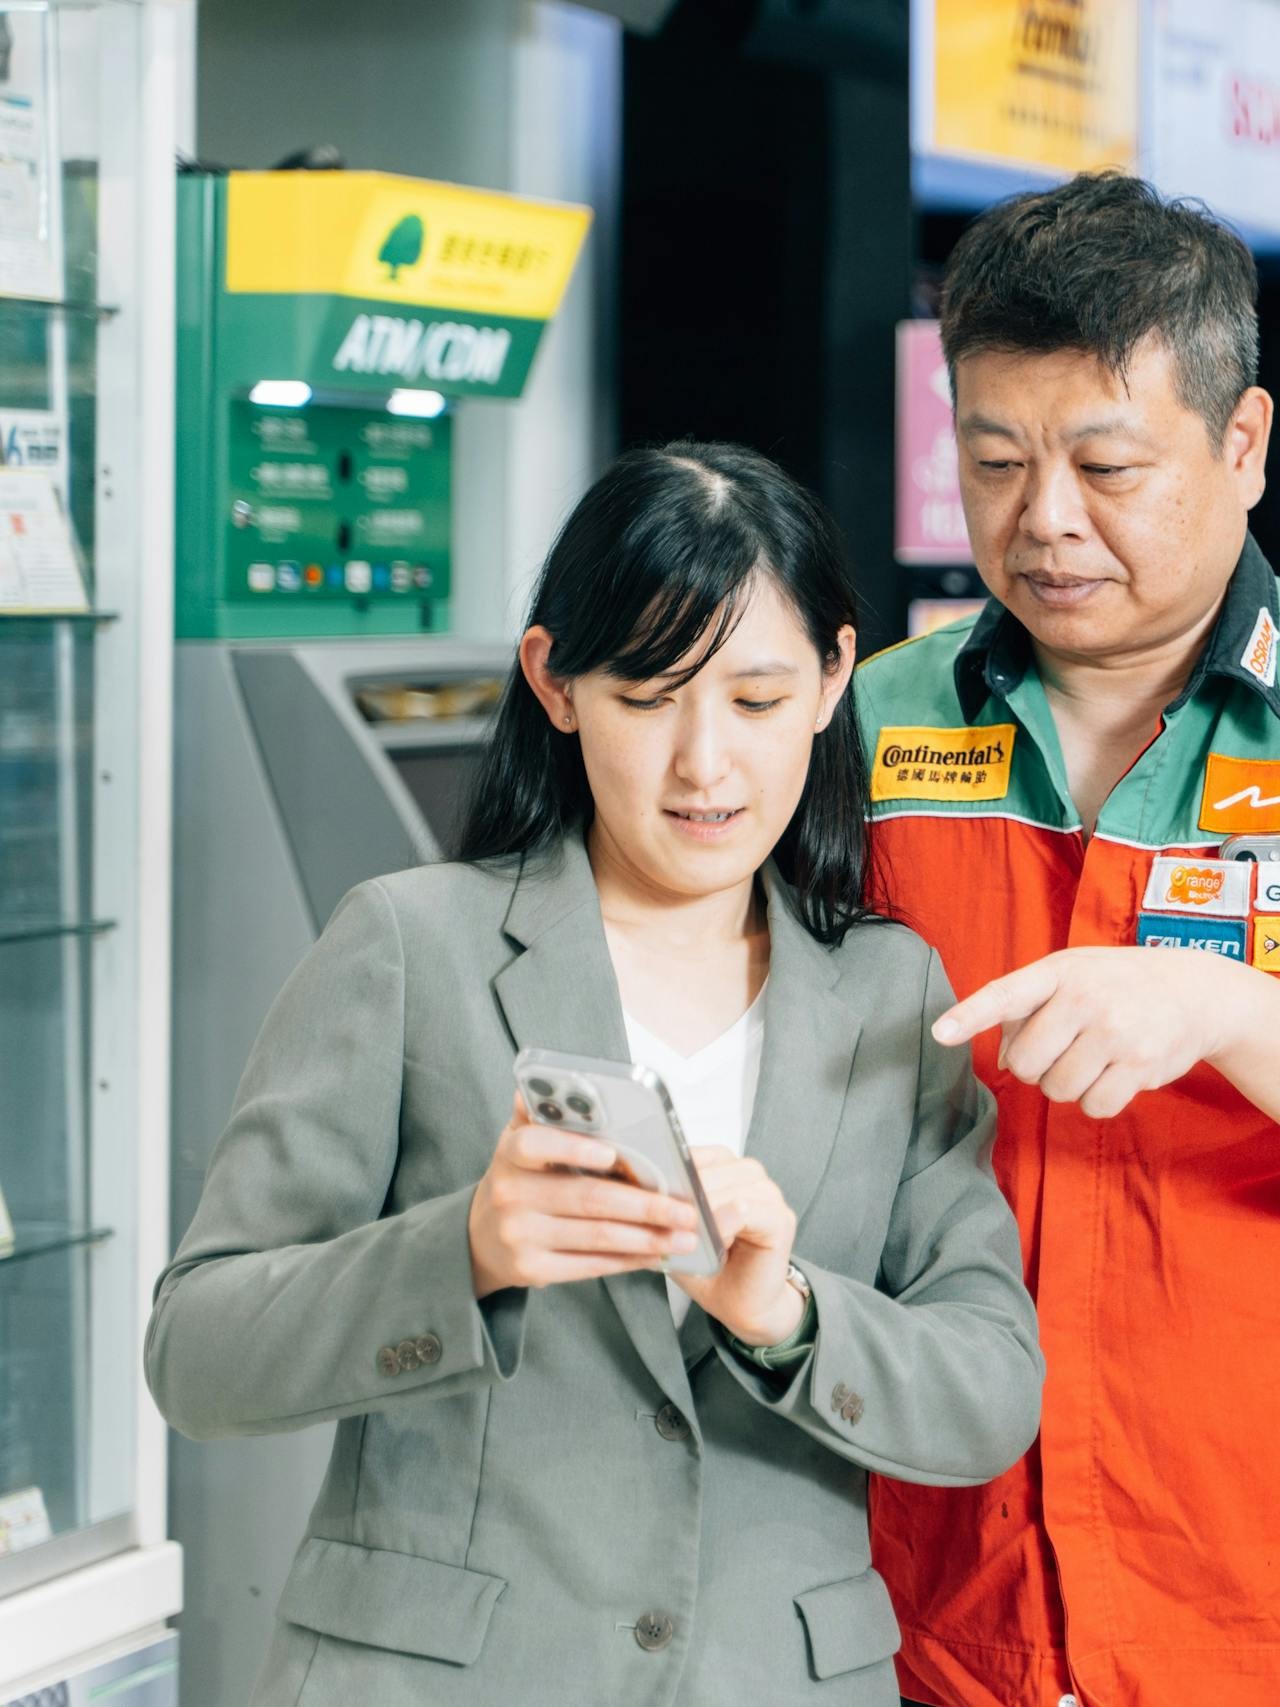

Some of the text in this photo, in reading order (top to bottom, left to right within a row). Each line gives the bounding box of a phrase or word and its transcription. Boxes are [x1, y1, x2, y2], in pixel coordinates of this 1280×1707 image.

[333, 314, 510, 385] ATM/CDM
[1250, 618, 1271, 673] OSRAM
[882, 744, 992, 768] Continental
[1170, 866, 1221, 891] Orange
[1145, 935, 1240, 955] FALKEN
